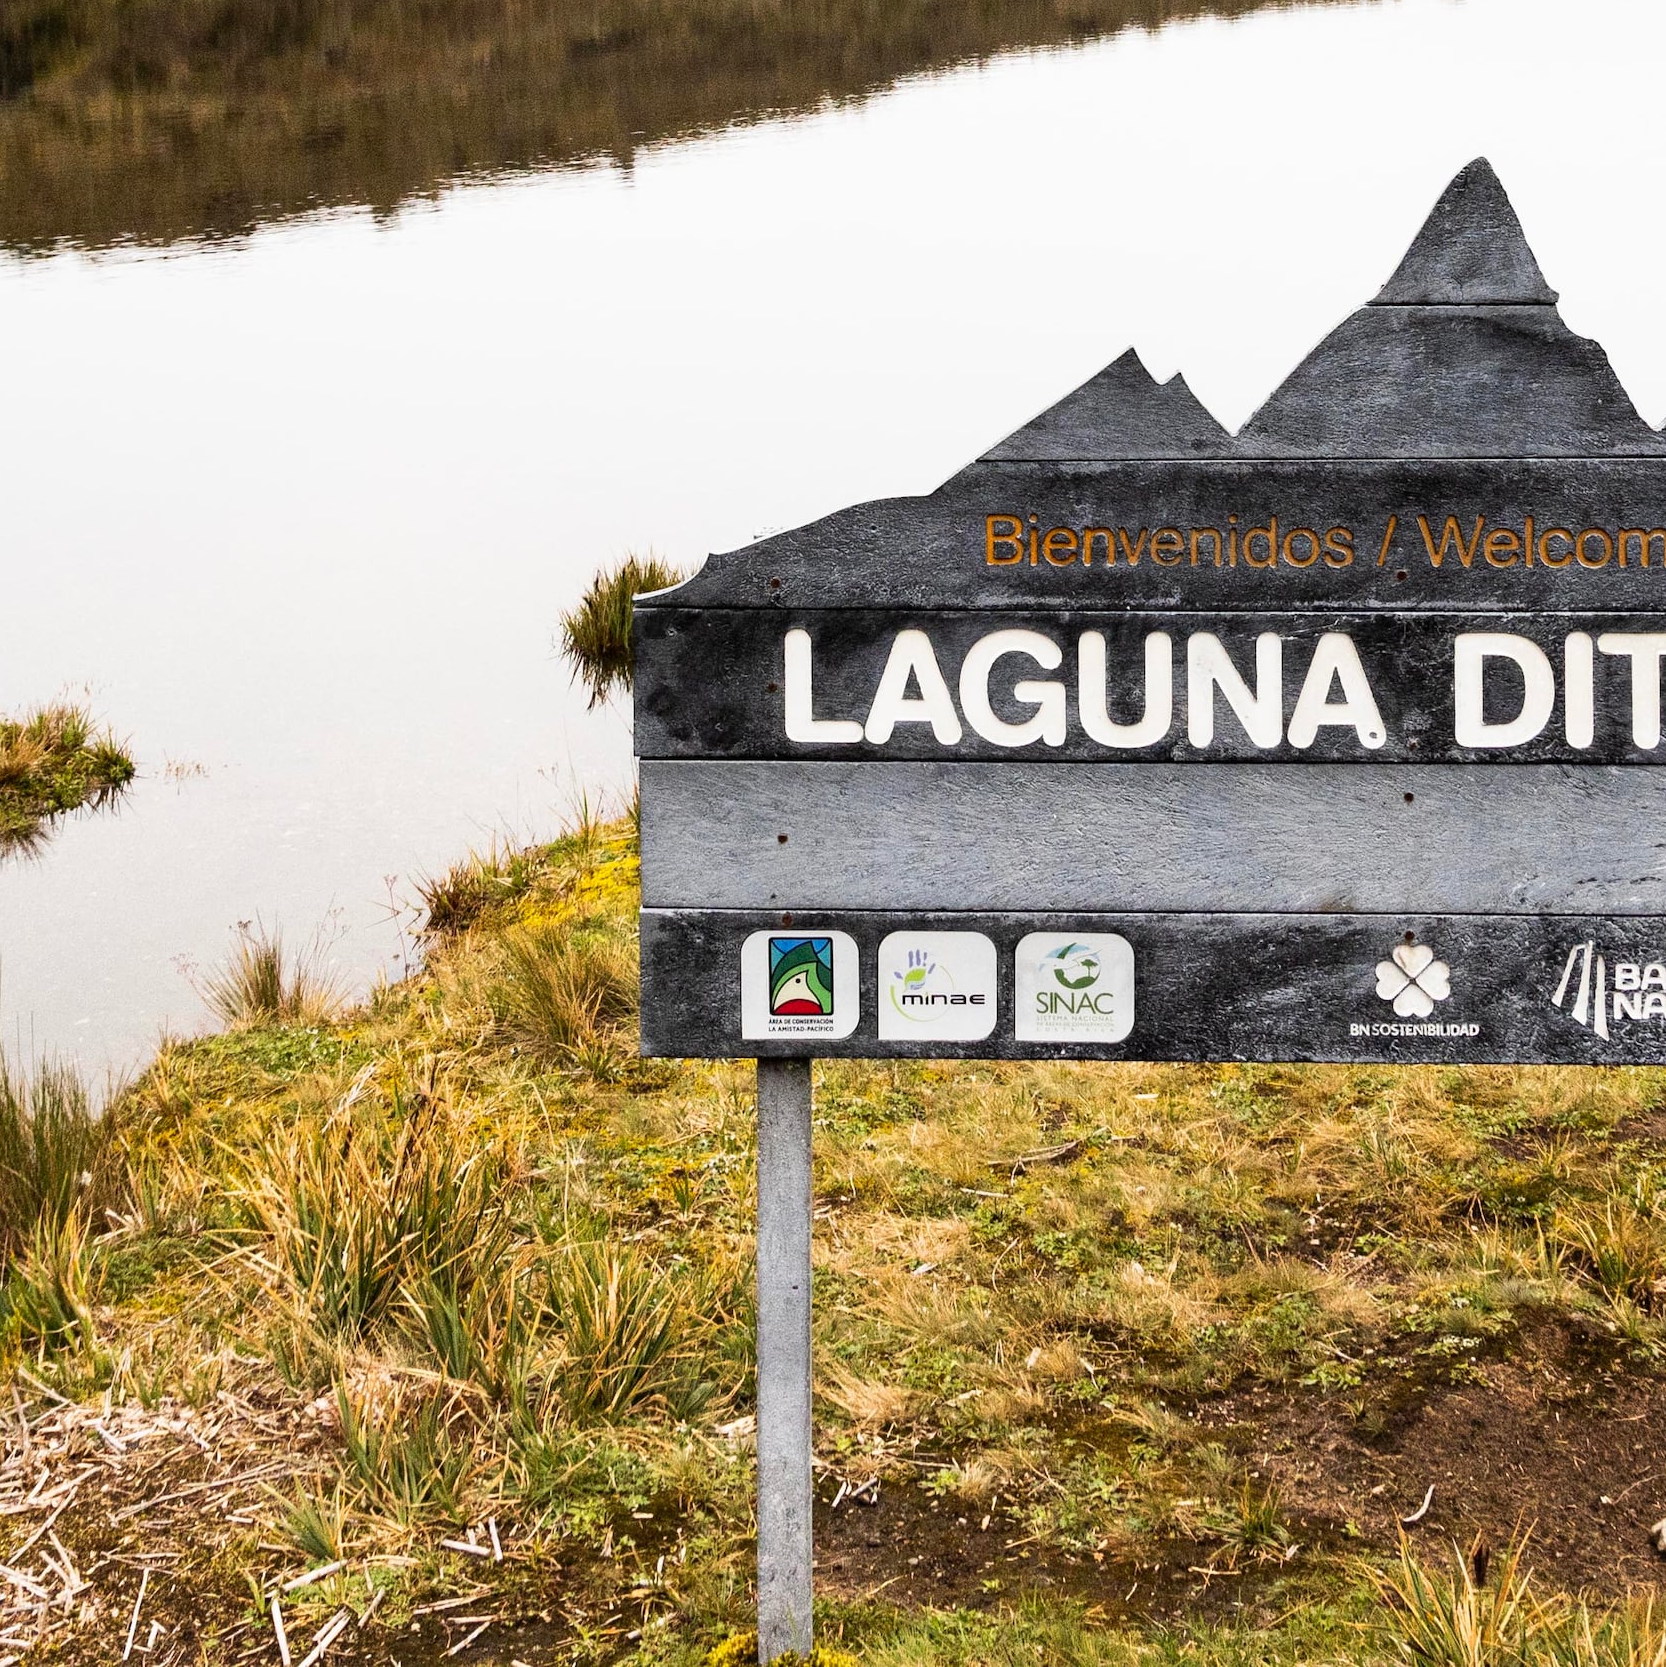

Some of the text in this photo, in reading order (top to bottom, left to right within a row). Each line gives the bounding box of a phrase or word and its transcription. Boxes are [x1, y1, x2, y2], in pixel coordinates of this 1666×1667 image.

[985, 514, 1354, 568] Bienvenidos
[1376, 514, 1398, 567] /
[784, 629, 1387, 750] LAGUNA
[902, 992, 985, 1005] minae
[1036, 992, 1114, 1014] SINAC
[1350, 1023, 1480, 1036] BN SOSTENIBILIDAD
